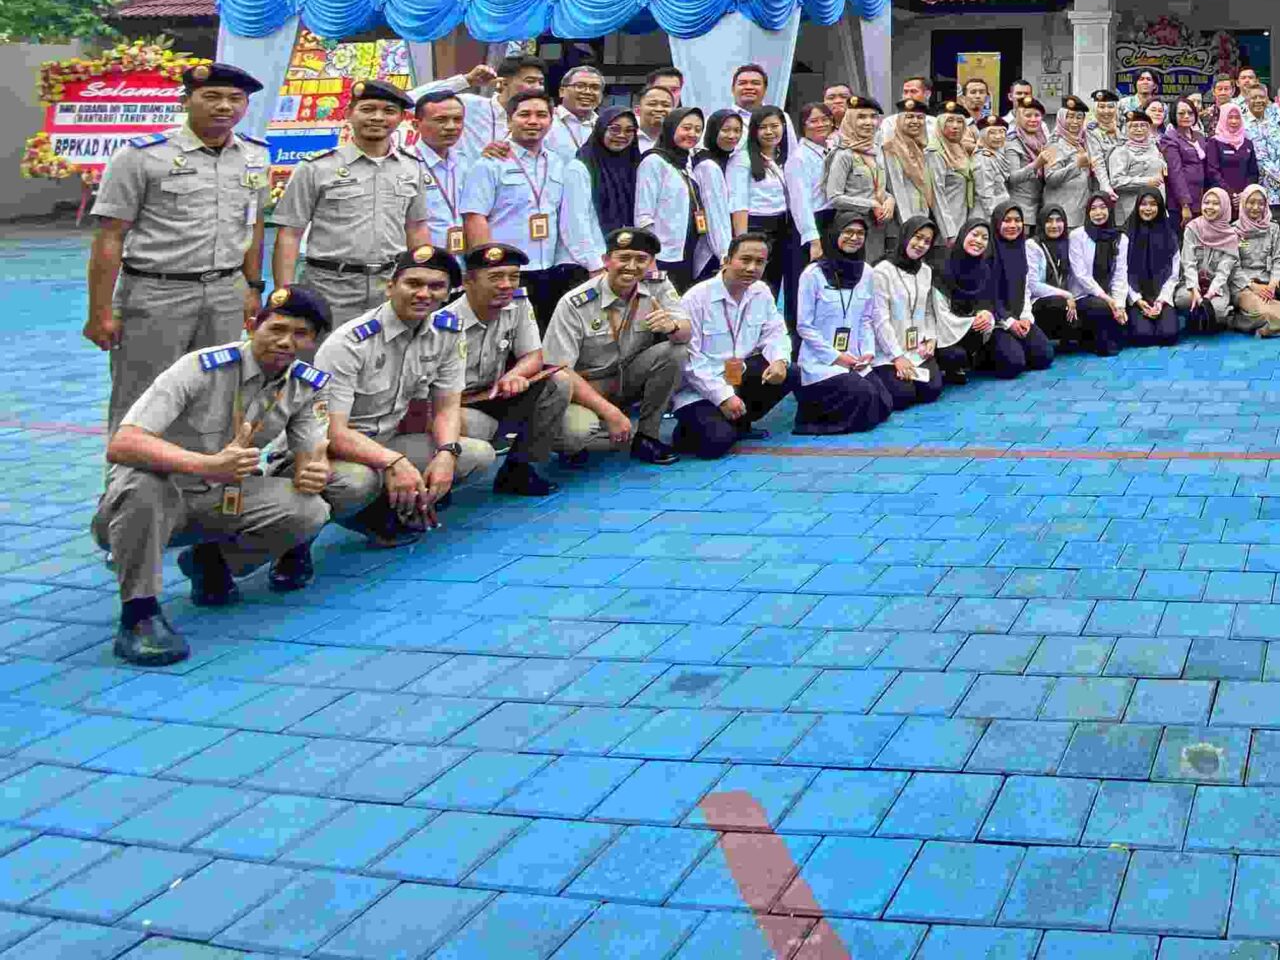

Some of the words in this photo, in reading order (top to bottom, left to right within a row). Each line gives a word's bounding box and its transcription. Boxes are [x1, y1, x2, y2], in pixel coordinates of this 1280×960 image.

[79, 80, 187, 98] Selamat
[152, 114, 176, 123] 2024
[54, 138, 100, 157] BPPKAD
